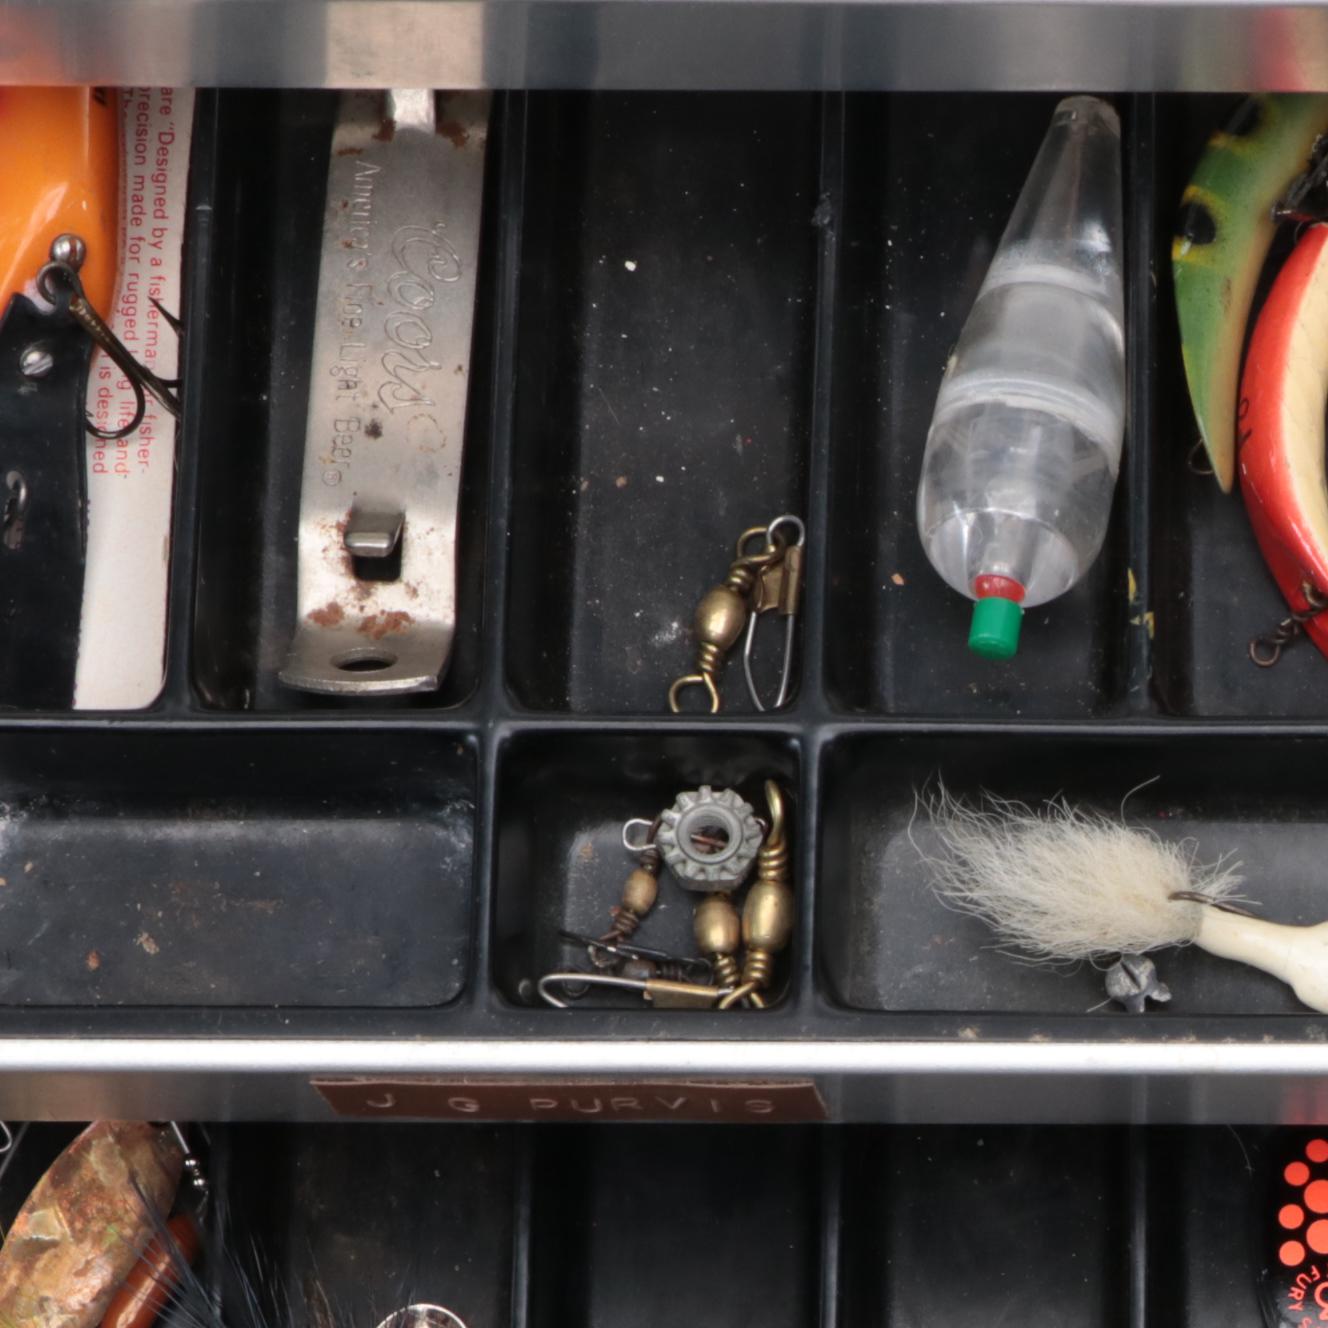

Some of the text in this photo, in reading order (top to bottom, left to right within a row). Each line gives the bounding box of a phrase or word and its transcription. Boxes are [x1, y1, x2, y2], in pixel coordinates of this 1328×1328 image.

[130, 175, 148, 227] made
[128, 236, 147, 263] for
[150, 227, 168, 250] by
[150, 258, 163, 268] a
[121, 271, 140, 342] rugged
[377, 221, 463, 415] Coors
[530, 1096, 776, 1114] PURVIS
[1287, 1264, 1322, 1313] FURY
